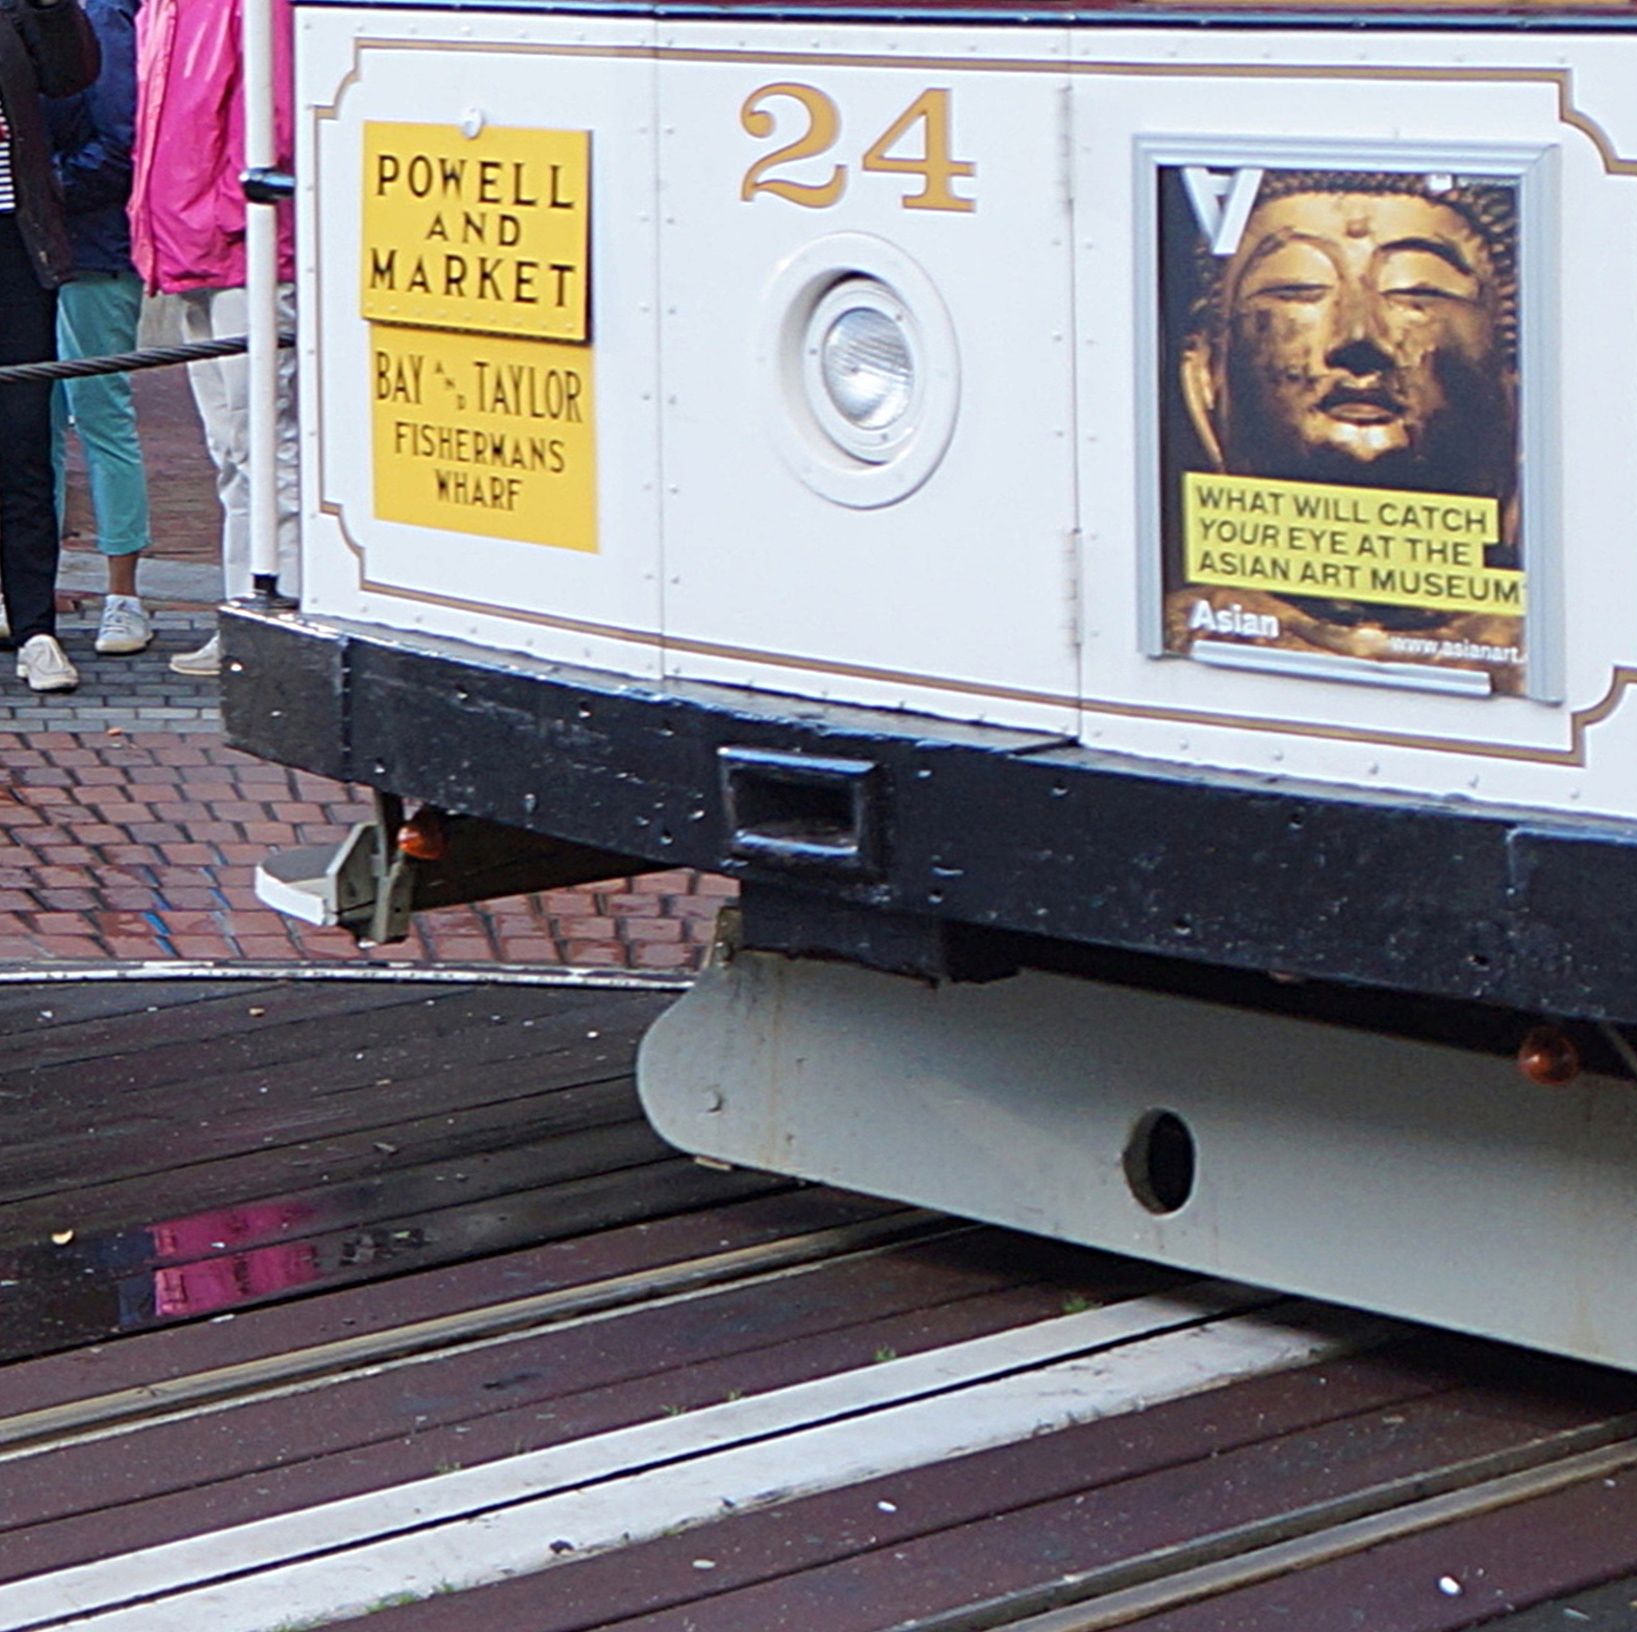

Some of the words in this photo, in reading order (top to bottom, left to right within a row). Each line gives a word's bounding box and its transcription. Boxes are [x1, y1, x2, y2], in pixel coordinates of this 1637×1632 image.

[740, 81, 977, 214] 24
[376, 154, 575, 210] POWELL
[424, 211, 522, 247] AND
[369, 247, 576, 308] MARKET
[375, 350, 424, 405] BAY
[473, 361, 584, 424] TAYLOR
[394, 420, 566, 474] FISHERMANS
[434, 468, 524, 512] WHARF
[1196, 484, 1285, 517] WHAT
[1292, 493, 1371, 525] WILL
[1377, 502, 1488, 535] CATCH
[1200, 518, 1280, 549] YOUR
[1287, 526, 1350, 556] EYE
[1356, 534, 1396, 560] AT
[1404, 537, 1472, 567] THE
[1197, 550, 1291, 582] ASIAN
[1299, 559, 1362, 589] ART
[1189, 598, 1280, 639] Asian
[1389, 635, 1527, 665] www.asianart.
